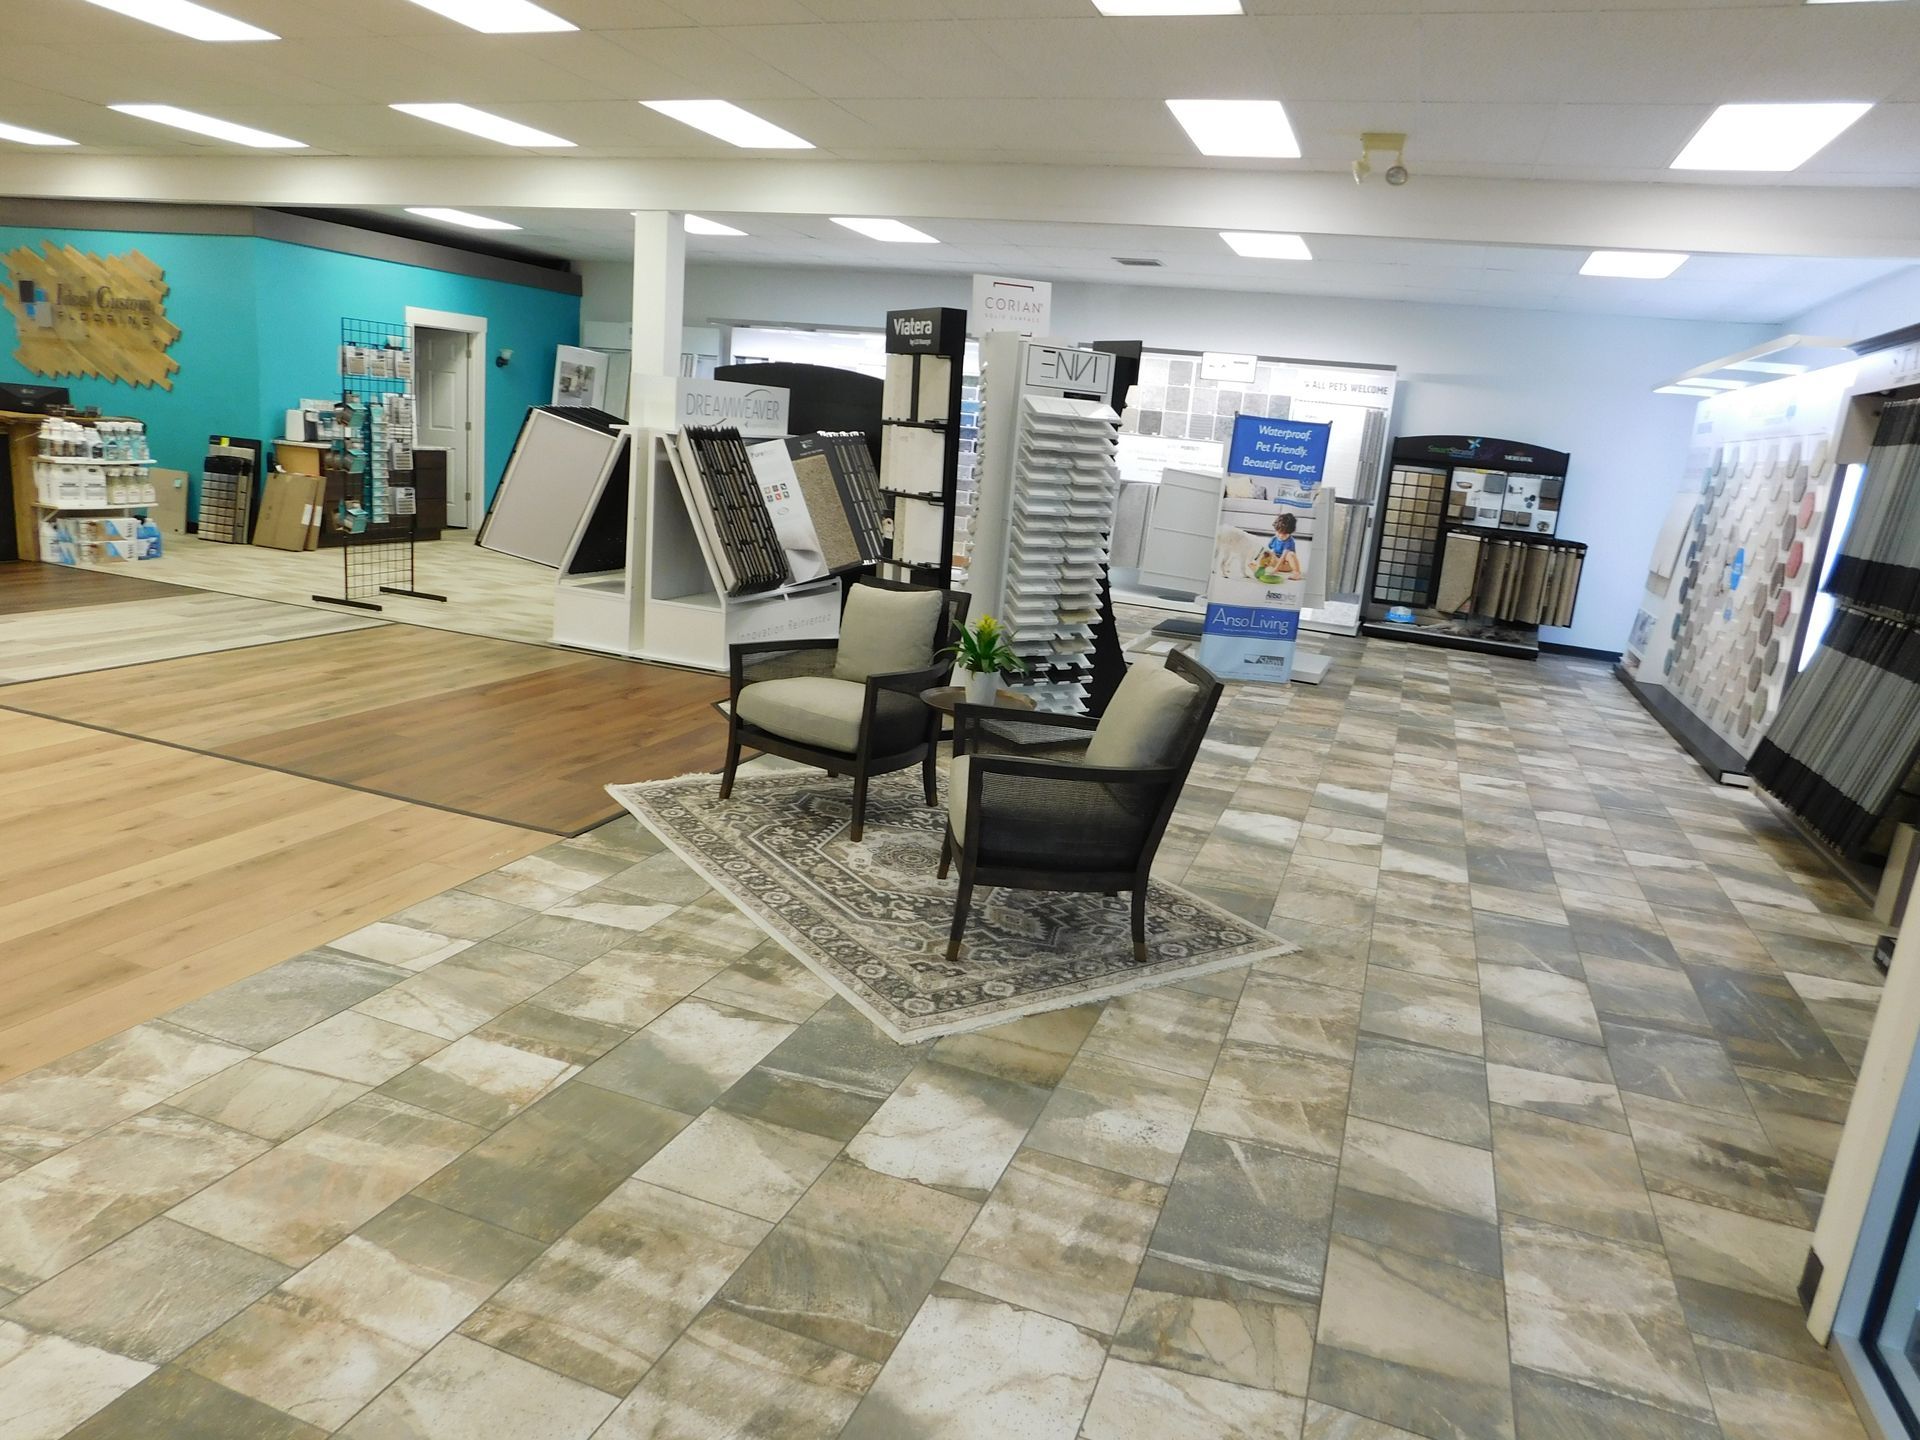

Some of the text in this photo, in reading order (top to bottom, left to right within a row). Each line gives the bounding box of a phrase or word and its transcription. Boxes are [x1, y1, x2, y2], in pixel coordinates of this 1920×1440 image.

[57, 310, 151, 326] FLOORING
[893, 317, 933, 336] Viatera
[1328, 382, 1347, 392] PETS
[1351, 384, 1389, 395] WELCOME
[686, 393, 780, 420] DREAMWEAVER
[1259, 424, 1313, 442] Waterproof.
[1255, 441, 1308, 458] Pet Friendly.
[1242, 456, 1317, 474] Beautiful Carpet.
